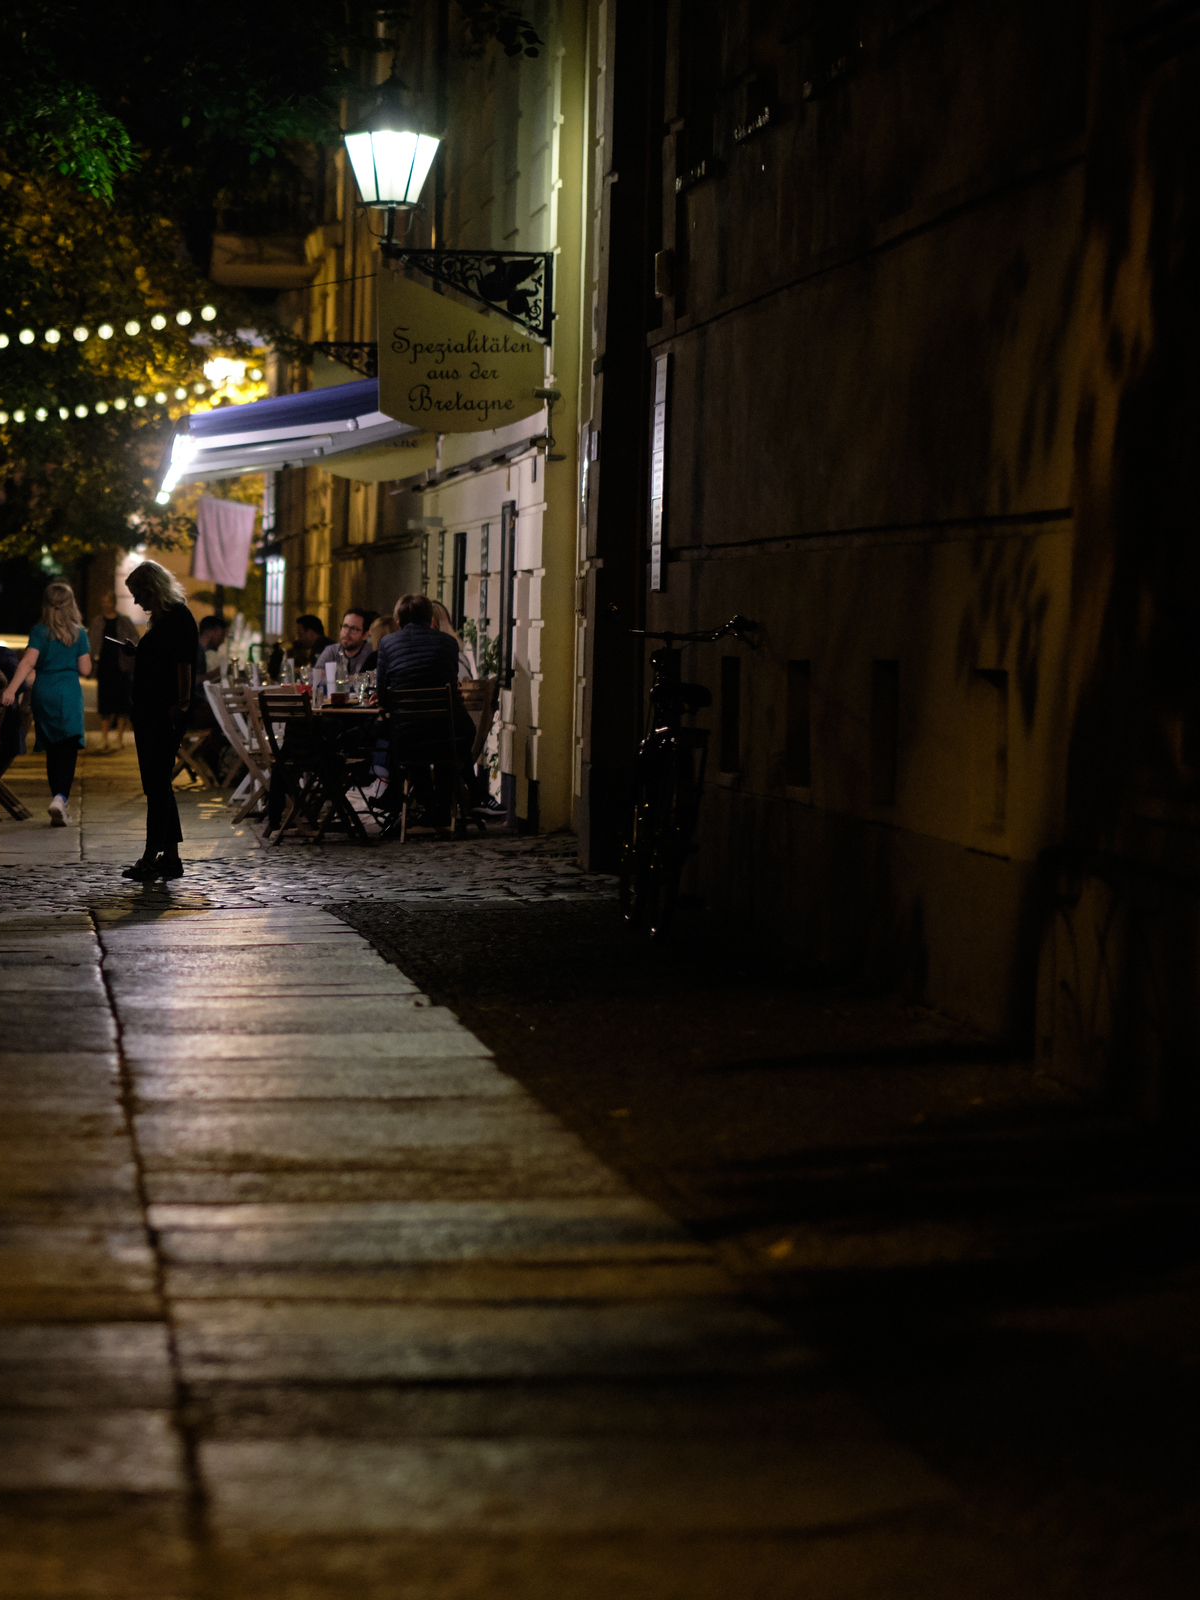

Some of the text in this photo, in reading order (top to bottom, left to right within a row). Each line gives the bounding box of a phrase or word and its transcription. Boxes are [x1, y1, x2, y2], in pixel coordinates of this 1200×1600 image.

[391, 327, 533, 364] Spezialitäten
[426, 361, 500, 380] aus der
[407, 384, 515, 422] Bretagne
